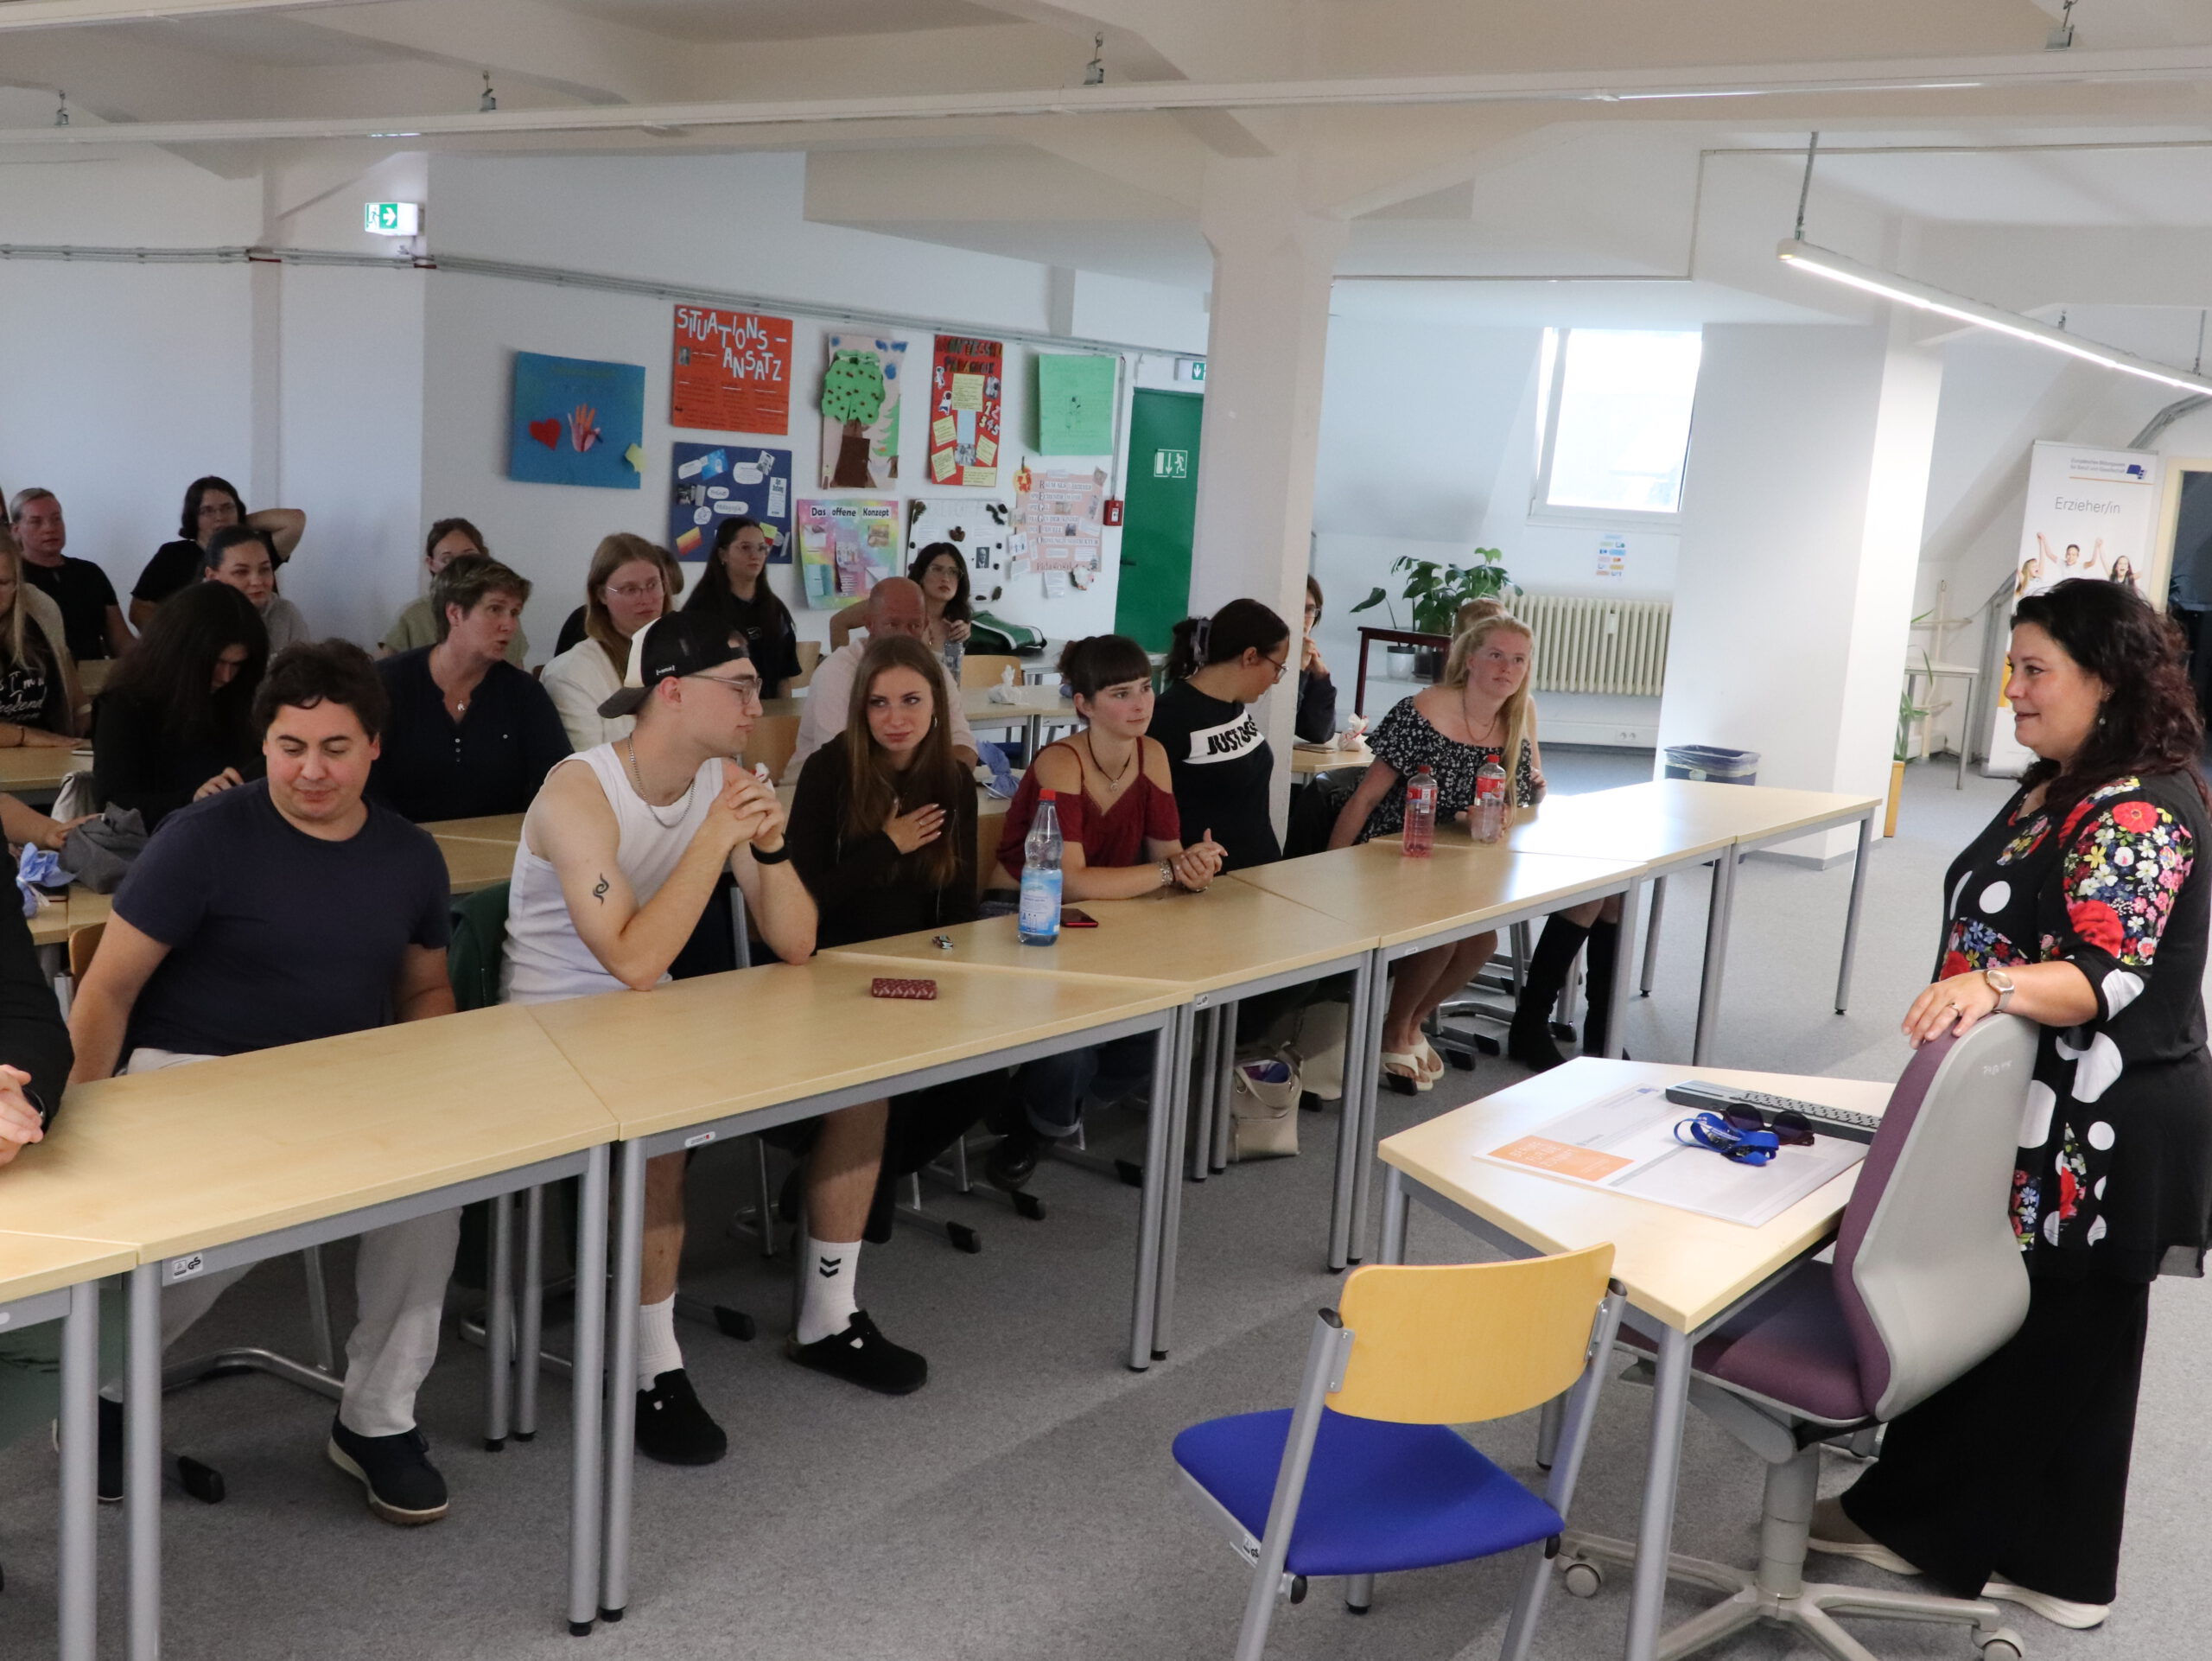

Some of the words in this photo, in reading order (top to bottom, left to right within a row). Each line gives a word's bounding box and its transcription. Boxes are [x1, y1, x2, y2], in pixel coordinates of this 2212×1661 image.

[722, 347, 782, 381] ANSATZ
[811, 507, 826, 517] Das
[831, 507, 856, 517] offene
[862, 507, 889, 518] Konzept
[2055, 497, 2121, 514] Erzieher/in
[1207, 729, 1243, 755] JUST
